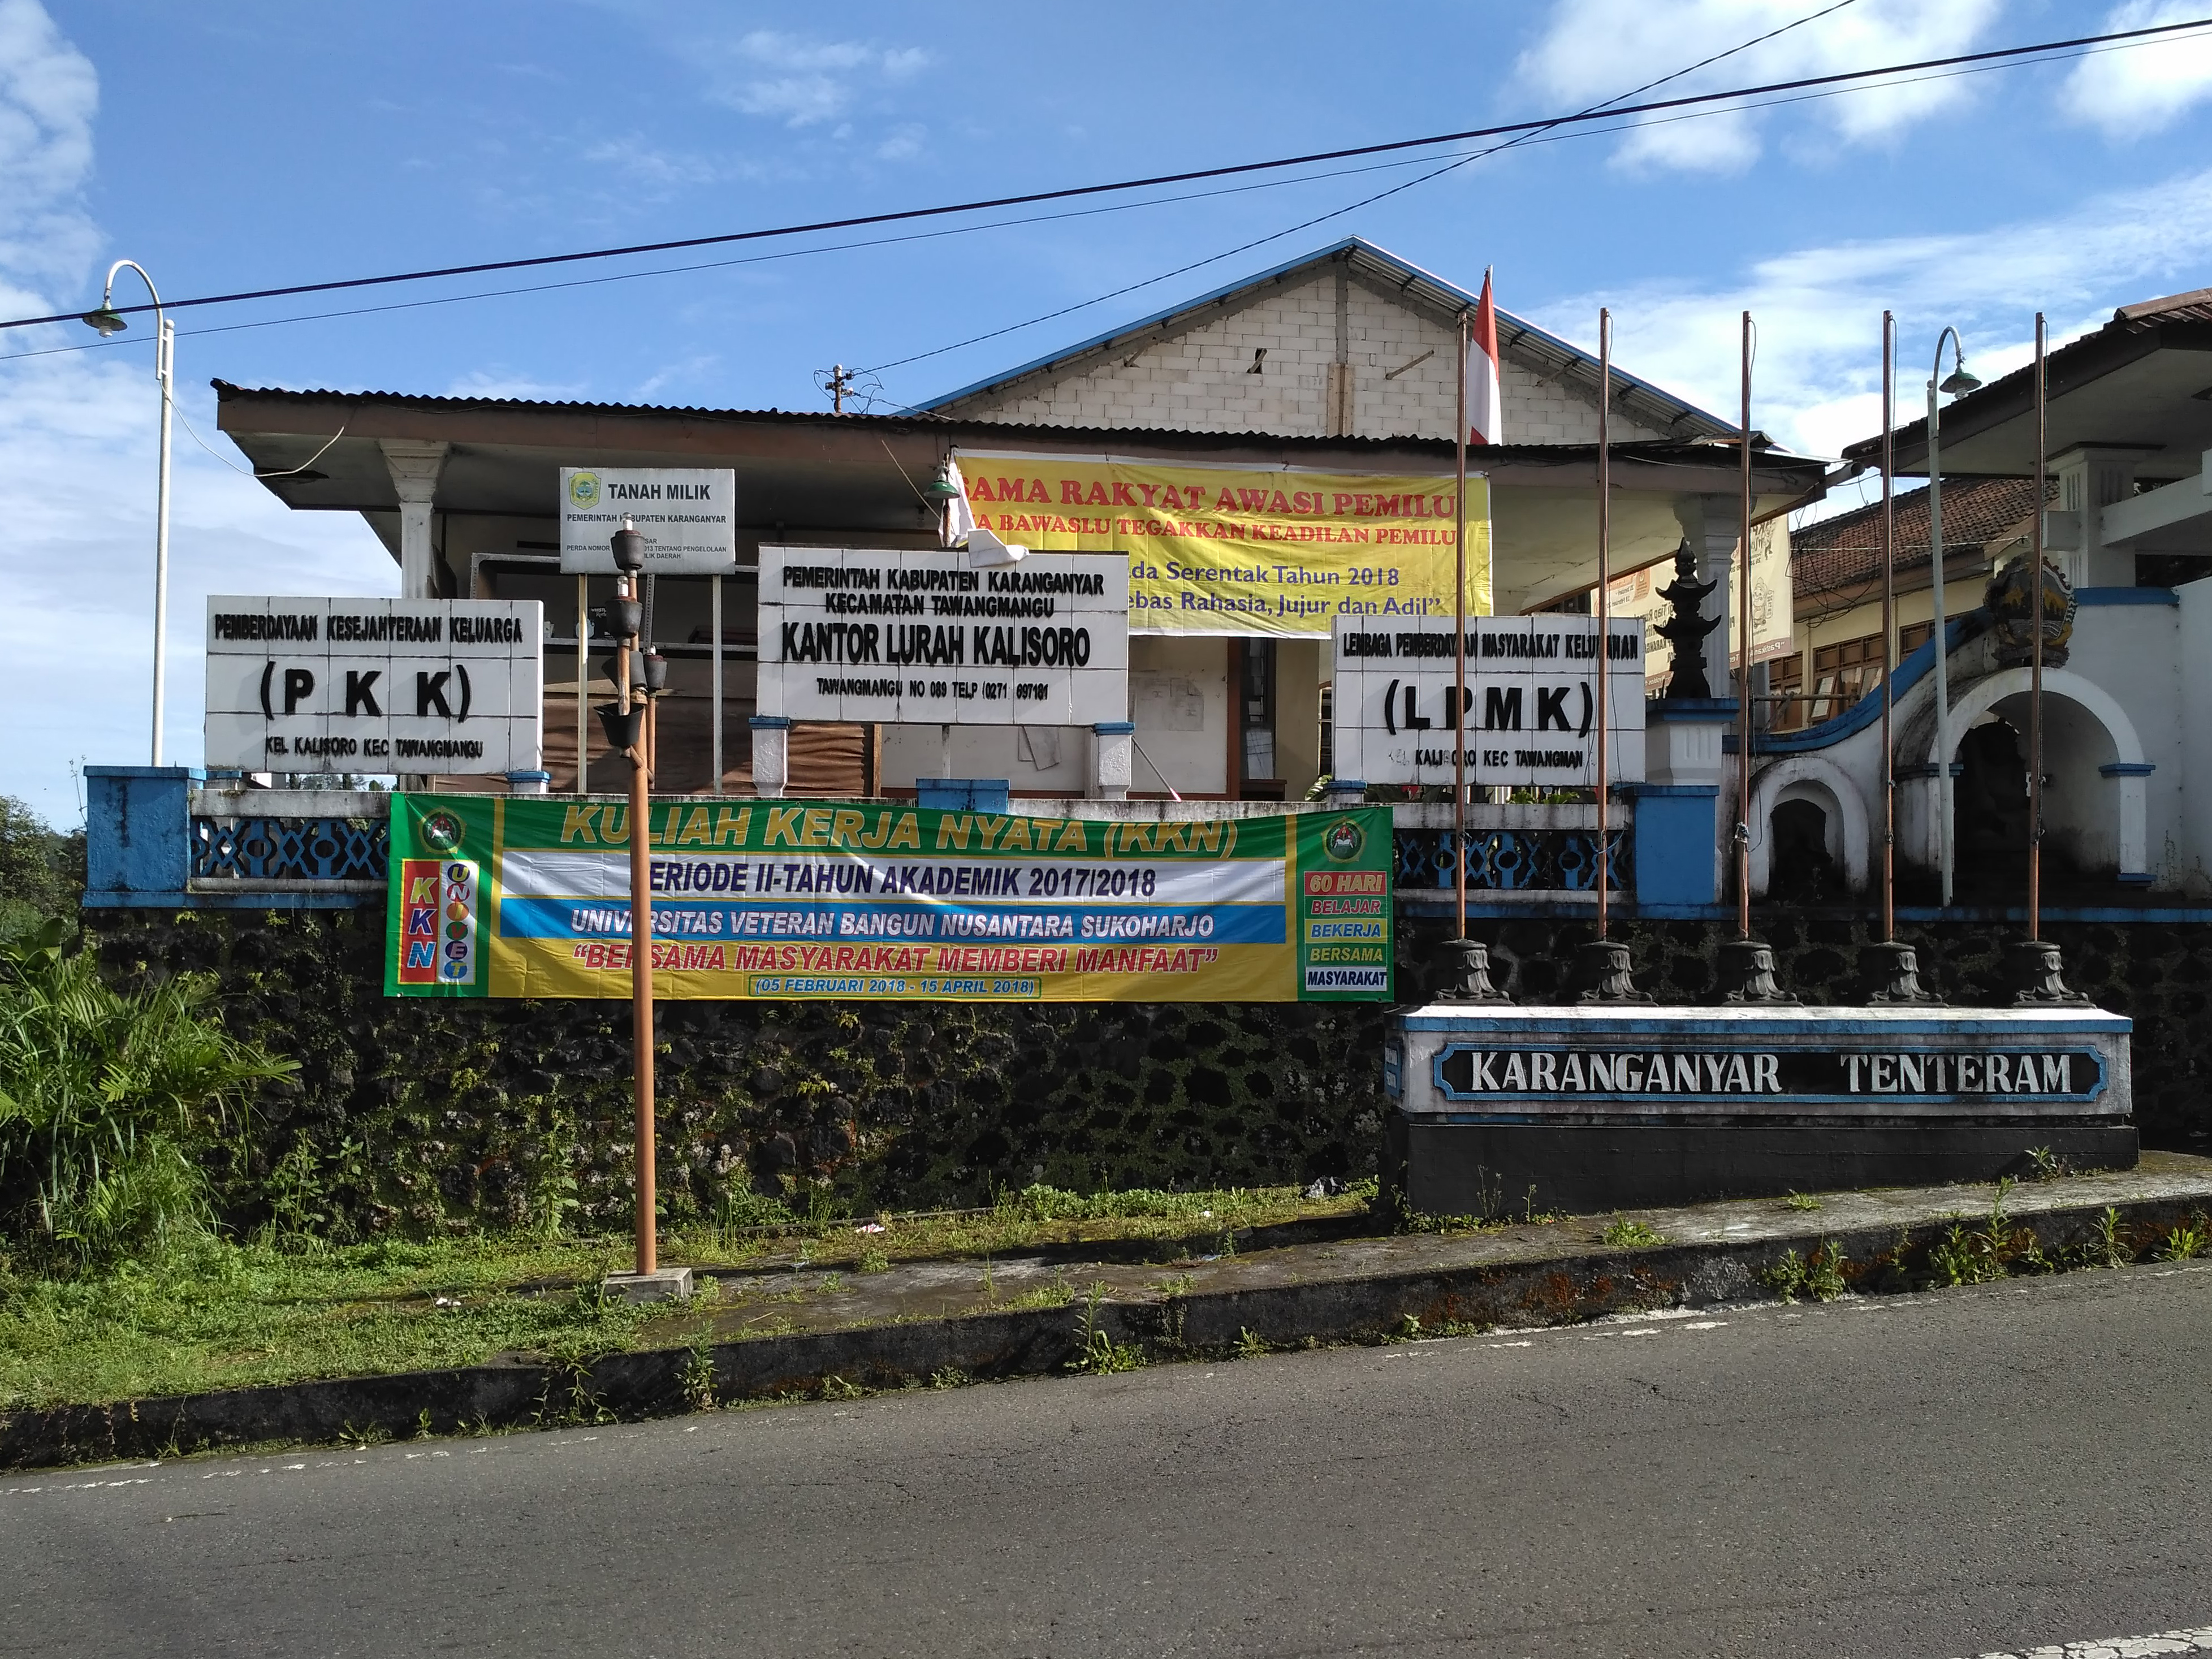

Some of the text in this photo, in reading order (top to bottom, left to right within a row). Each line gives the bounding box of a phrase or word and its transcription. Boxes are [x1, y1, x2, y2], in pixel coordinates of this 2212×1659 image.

[608, 483, 711, 500] TANAH MILIK
[1060, 479, 1206, 511] RAKYAT
[1213, 488, 1323, 515] AWASI
[1334, 492, 1455, 519] PEMILU
[567, 514, 617, 522] PEMERINTAH
[668, 515, 727, 523] KARANGANYAR
[973, 514, 1457, 546] A BAWASLU TEGAKKAN KEADILAN PEMILU
[783, 566, 1104, 595] PEMERINTAH KABUPATEN KARANGANYAR
[1129, 561, 1399, 586] da Serentak Tahun 2018
[826, 593, 1055, 617] KECAMATAN TAWANGMANGU
[1181, 591, 1273, 614] Rahasia,
[1278, 595, 1330, 618] Jujur
[1338, 597, 1377, 616] dan
[215, 614, 523, 643] PEMBERDAYAAN KESEJAHTERAAN KELUARGA
[783, 622, 1090, 666] KANTOR LURAH KALISORO
[1343, 633, 1392, 657] LEMBAGA
[1396, 633, 1478, 658] PEMBERDAYAN
[1482, 634, 1559, 658] MASYARAKAT
[817, 677, 903, 698] TAWANGMANGU
[909, 680, 925, 698] NO
[930, 680, 947, 698] 089
[952, 681, 978, 699] TELP
[266, 736, 483, 759] KEL KALISORO KEC TAWANGMANGU
[1484, 750, 1508, 767] KEC
[764, 807, 921, 850] KERJA
[936, 815, 1087, 851] NYATA
[1104, 820, 1238, 858] (KKN)
[649, 862, 746, 893] ERIODE
[755, 863, 873, 894] II-TAHUN
[880, 865, 1021, 896] AKADEMIK
[1310, 874, 1382, 893] 60 HARI
[1311, 899, 1381, 915] BELAJAR
[407, 876, 438, 969] KKN
[572, 908, 1214, 938] UNIVRSITAS VETERAN BANGUN NUSANTARA SUKOHARJO
[1310, 922, 1381, 938] BEKERJA
[735, 945, 926, 973] MASYARAKAT
[937, 948, 1068, 973] MEMBERI
[1075, 948, 1217, 974] MANFAAT”
[1310, 946, 1383, 962] BERSAMA
[755, 977, 780, 994] (05
[784, 978, 863, 993] FEBRUARI
[868, 979, 905, 993] 2018
[922, 980, 938, 993] 15
[941, 979, 988, 993] APRIL
[991, 979, 1034, 997] 2018)
[1307, 971, 1387, 988] MASYARAKAT
[1471, 1052, 2071, 1094] KARANGANYAR TENTERAM
